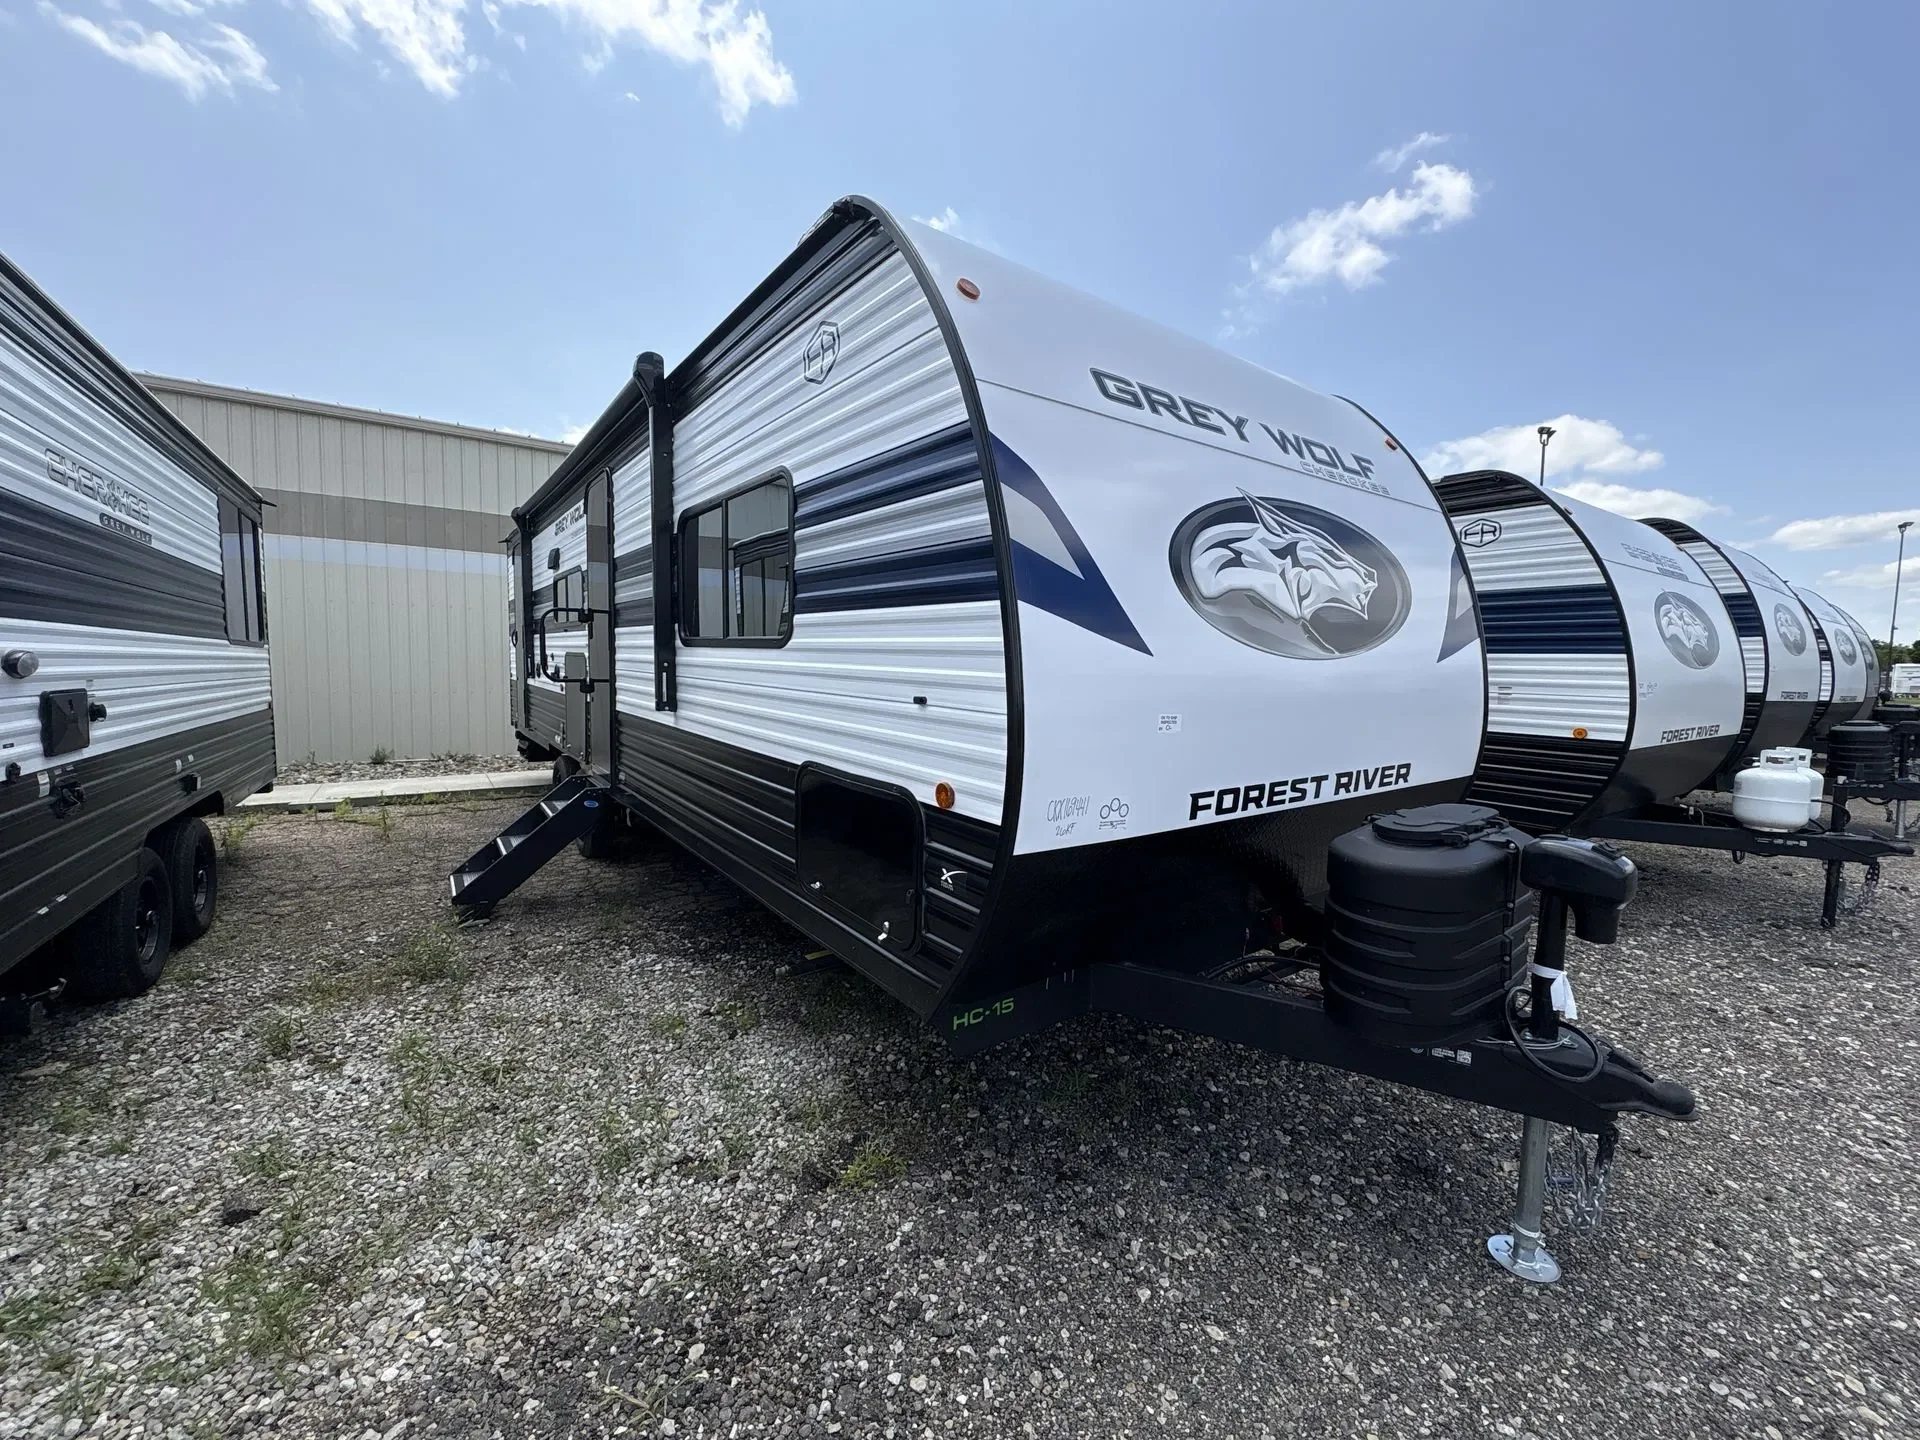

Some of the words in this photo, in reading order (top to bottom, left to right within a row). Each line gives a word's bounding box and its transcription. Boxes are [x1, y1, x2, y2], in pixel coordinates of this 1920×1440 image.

[1090, 367, 1250, 444] GREY
[1258, 422, 1376, 481] WOLF
[1299, 460, 1391, 496] CHEROKEE
[1660, 726, 1697, 744] FOREST
[1696, 724, 1721, 739] RIVER
[1188, 773, 1330, 821] FOREST
[1333, 762, 1412, 796] RIVER
[952, 997, 1015, 1031] HC-15
